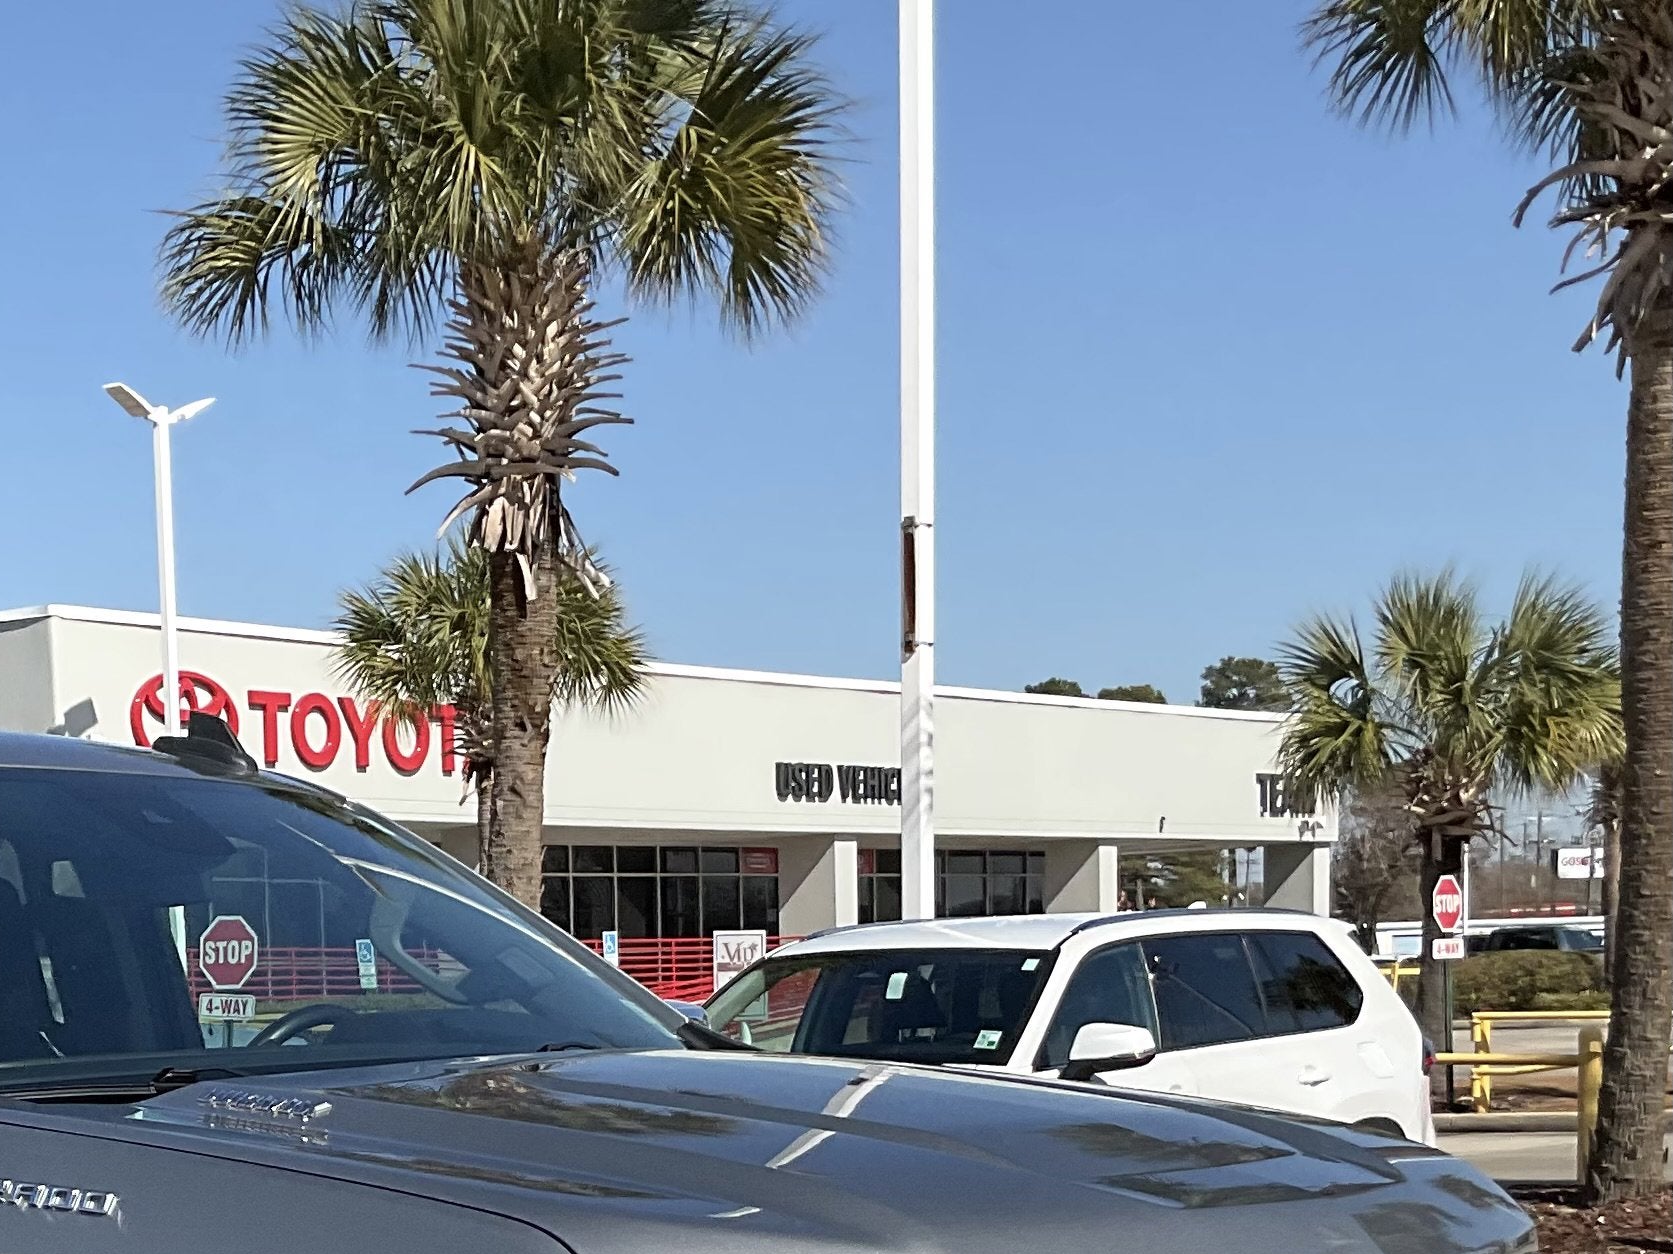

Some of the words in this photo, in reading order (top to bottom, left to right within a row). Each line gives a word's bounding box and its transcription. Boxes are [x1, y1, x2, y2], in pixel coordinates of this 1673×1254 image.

[247, 690, 471, 776] TOYOT
[774, 762, 834, 802] USED
[836, 764, 903, 805] VEHIC
[1435, 893, 1460, 913] STOP
[204, 940, 253, 965] STOP
[1437, 943, 1459, 954] 4-WAY
[205, 998, 249, 1016] 4-WAY
